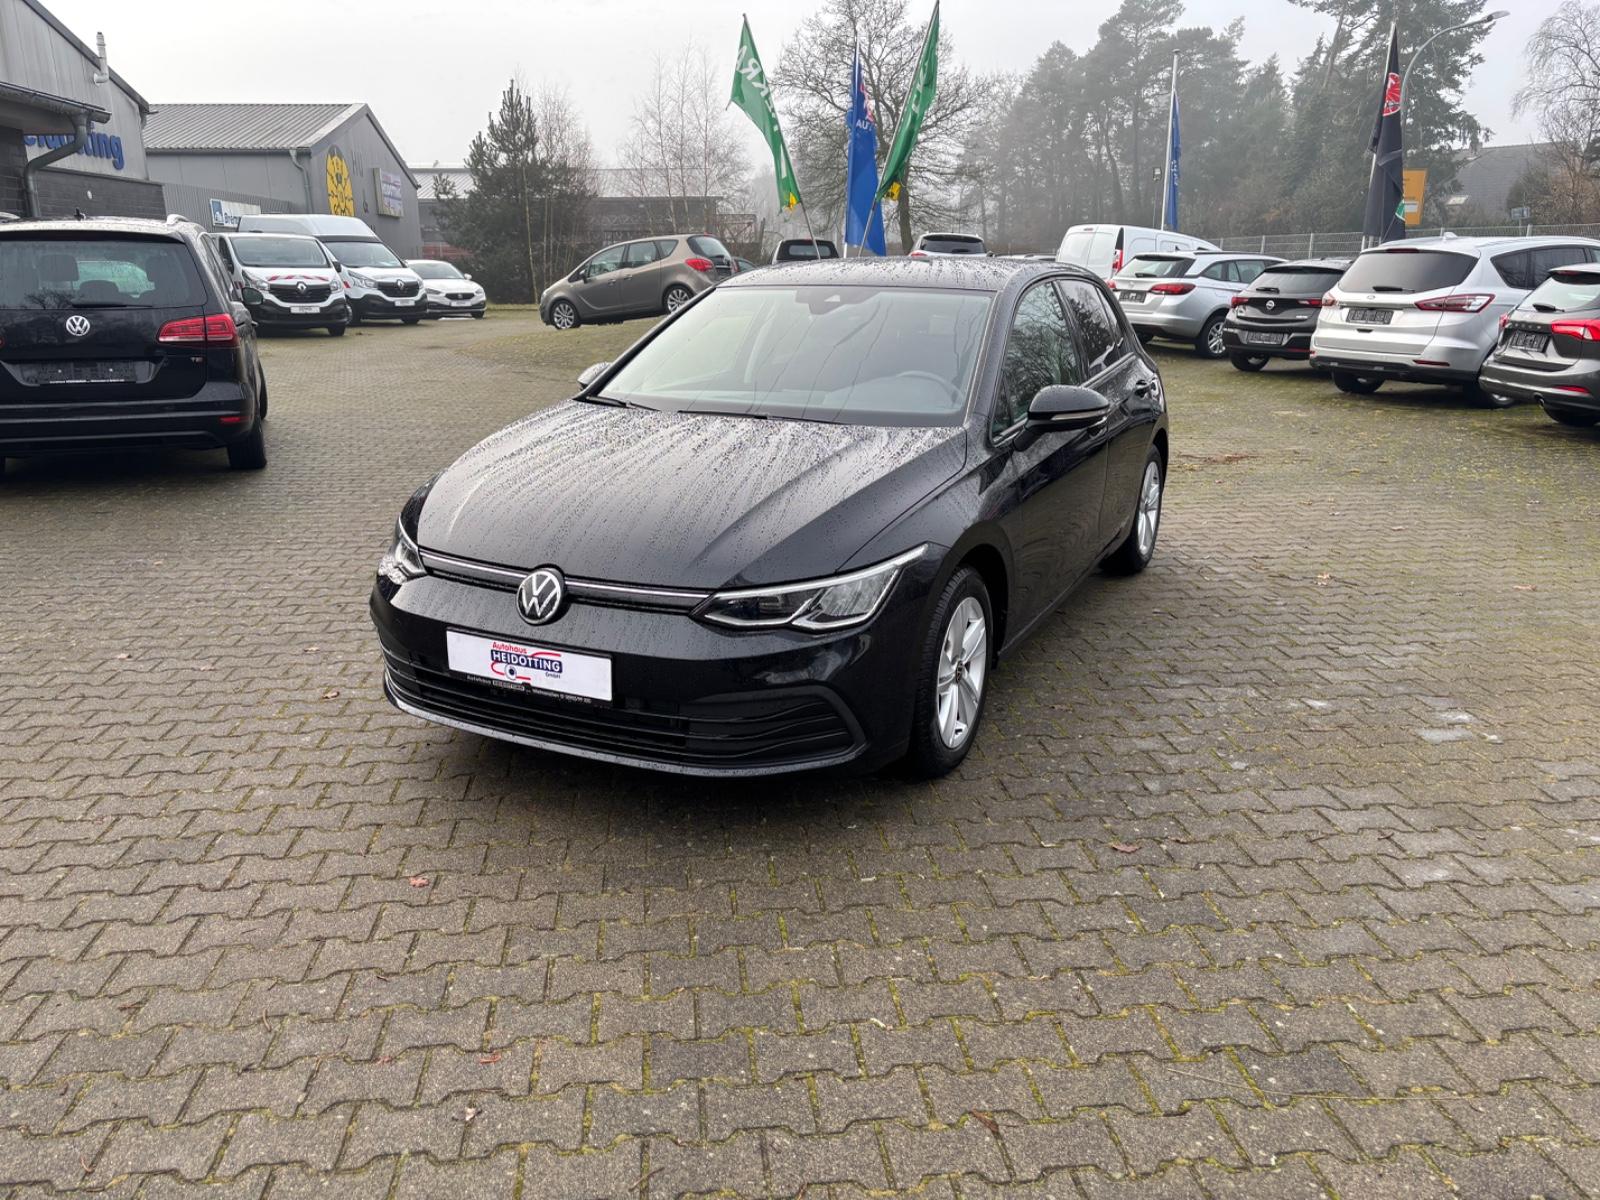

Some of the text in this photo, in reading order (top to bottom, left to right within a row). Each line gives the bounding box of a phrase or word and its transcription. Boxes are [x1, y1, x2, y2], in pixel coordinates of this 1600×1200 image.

[66, 315, 90, 336] VW
[517, 567, 561, 624] VW
[492, 641, 528, 654] Autohaus
[492, 650, 561, 672] HEIDOTTING
[545, 671, 561, 679] GmbH
